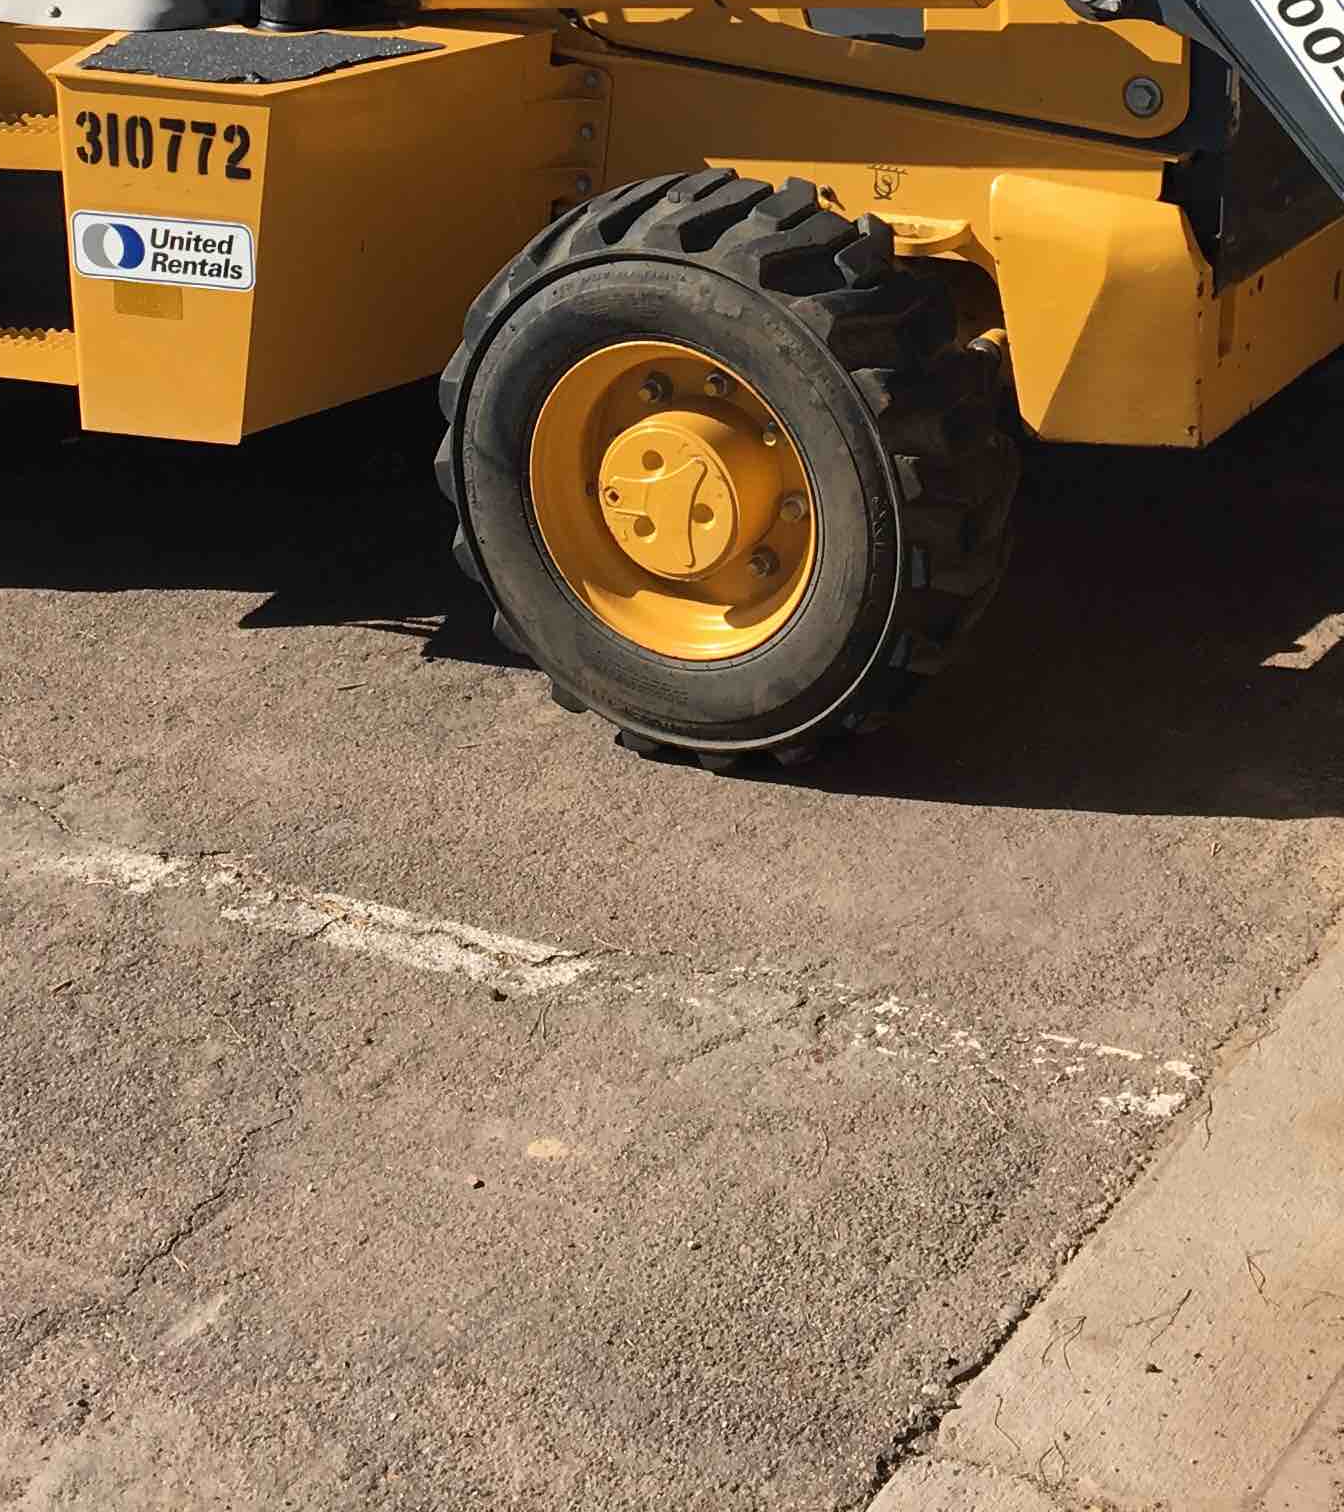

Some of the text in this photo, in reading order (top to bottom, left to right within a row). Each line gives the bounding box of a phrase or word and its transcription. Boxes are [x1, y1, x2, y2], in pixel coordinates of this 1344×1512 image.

[76, 111, 252, 180] 310772
[150, 228, 235, 255] United
[151, 251, 244, 280] Rentals
